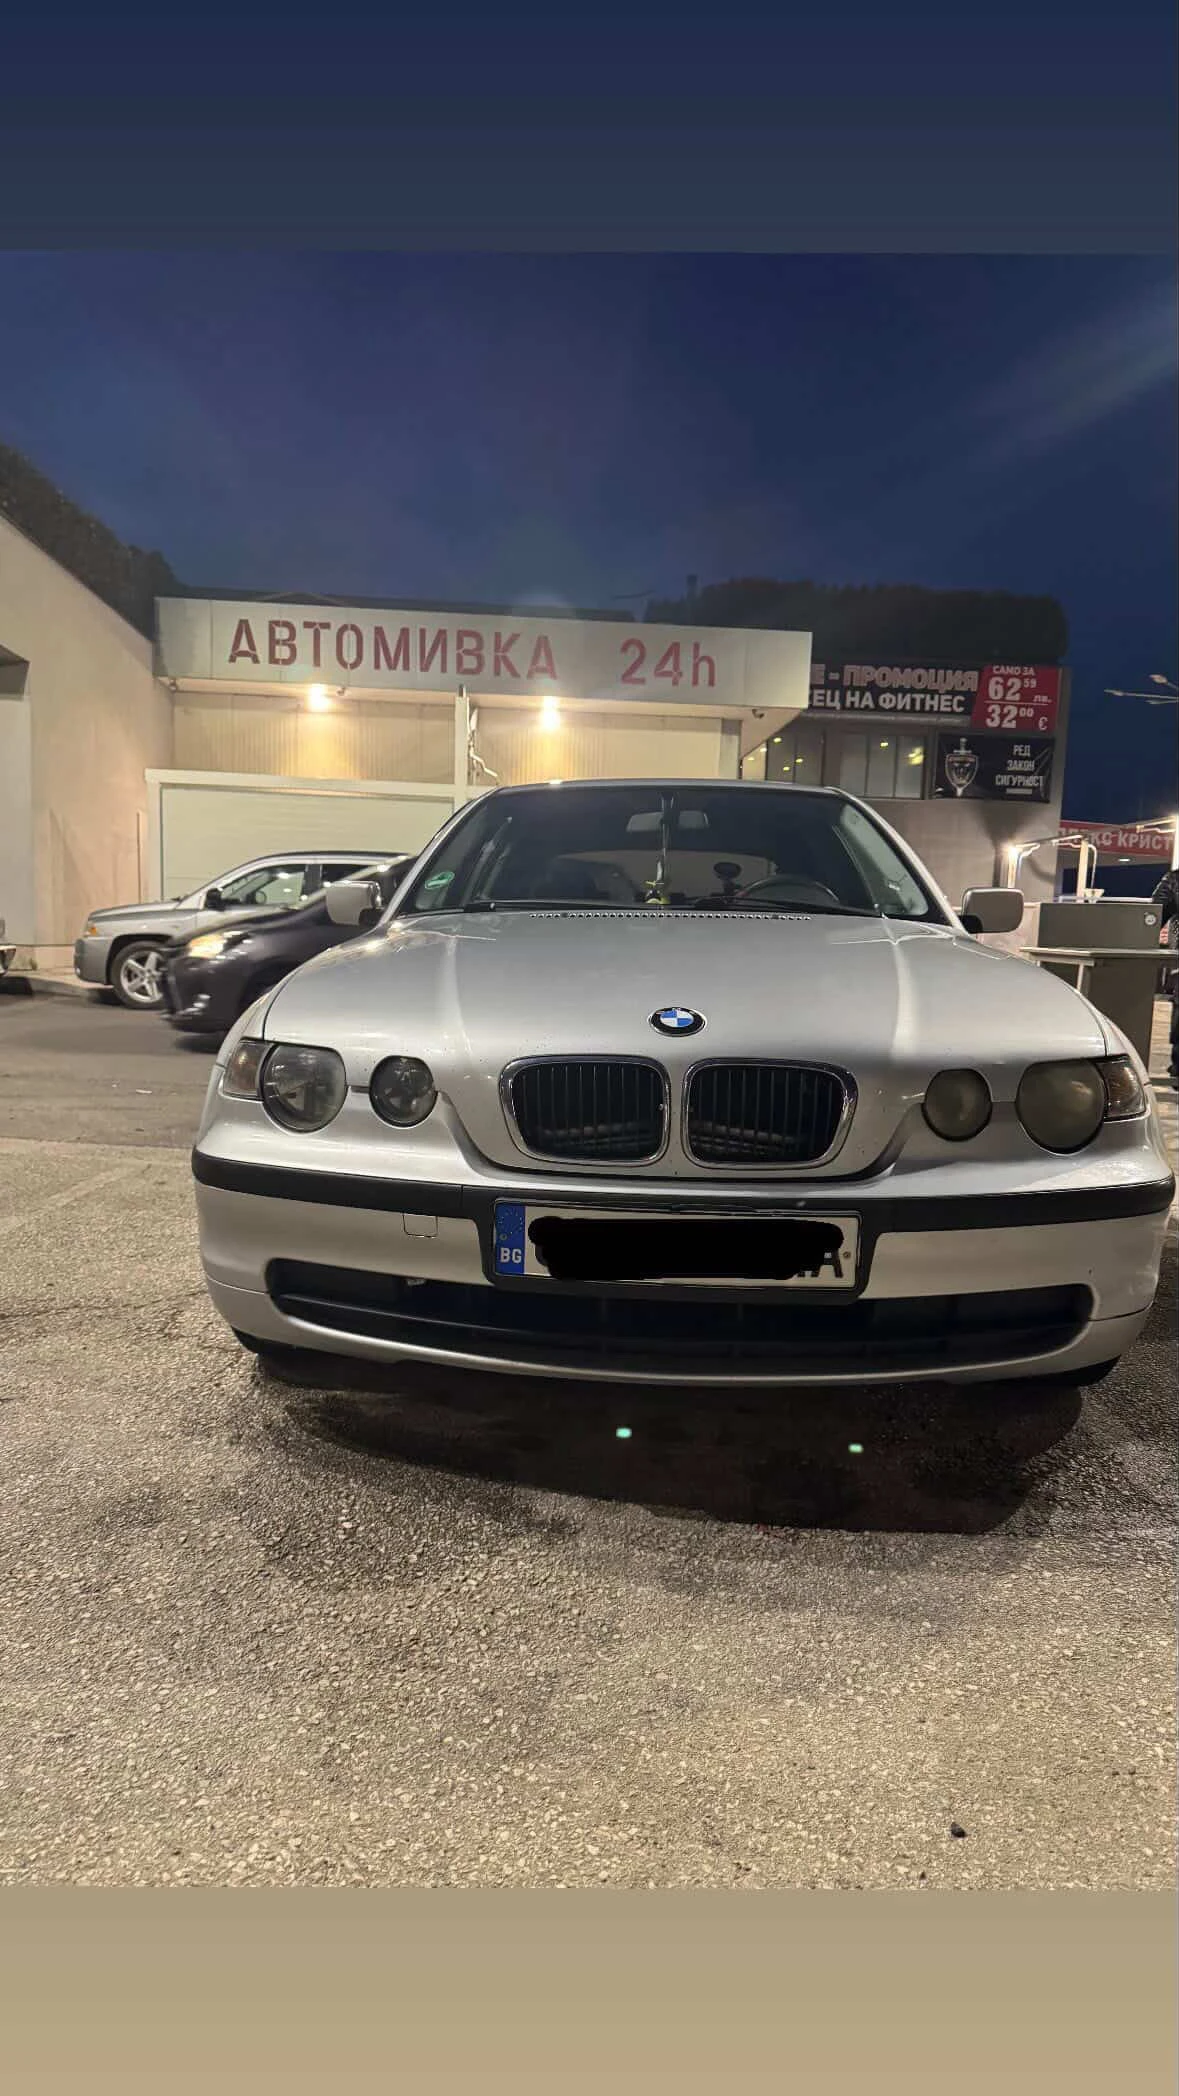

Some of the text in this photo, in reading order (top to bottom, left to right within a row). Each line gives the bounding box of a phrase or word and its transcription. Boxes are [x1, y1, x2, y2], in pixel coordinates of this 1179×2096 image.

[228, 619, 715, 687] АВТОМИВКА 24h
[843, 665, 978, 693] ПРОМОЦИЯ
[993, 665, 1036, 676] САМО ЗА
[988, 676, 1021, 700] 62
[810, 689, 965, 712] ЕЦ НА ФИТНЕС
[985, 704, 1018, 728] 32
[1019, 707, 1034, 717] 00
[1012, 744, 1031, 757] РЕД
[1007, 760, 1035, 771] ЗАКОН
[500, 1247, 522, 1264] BG
